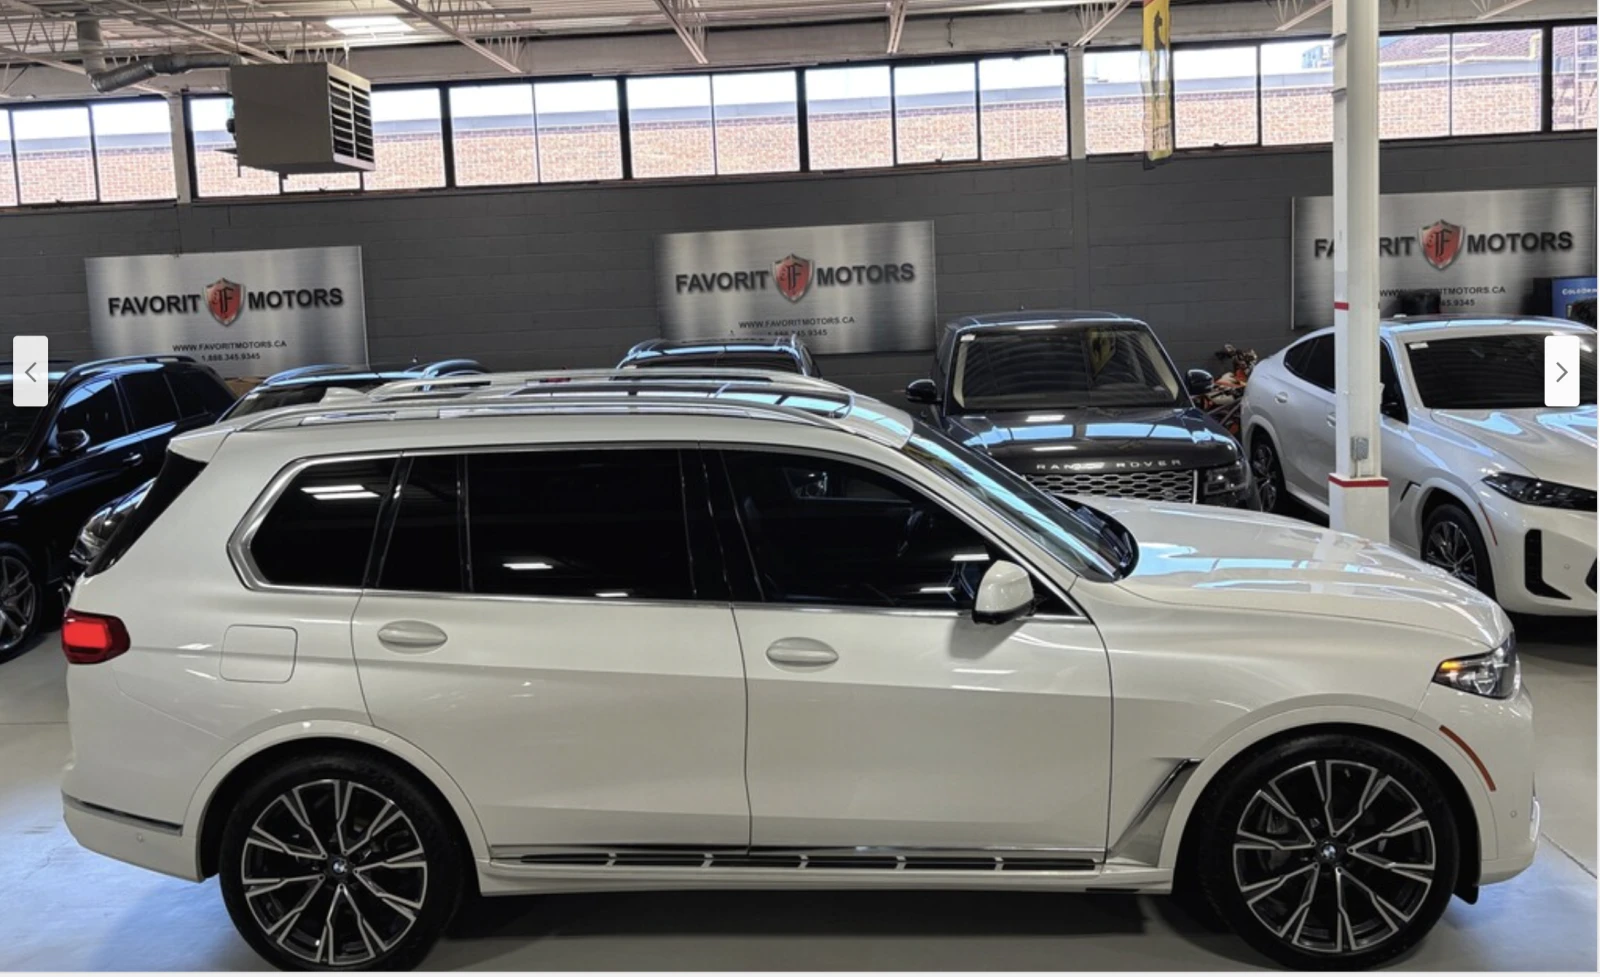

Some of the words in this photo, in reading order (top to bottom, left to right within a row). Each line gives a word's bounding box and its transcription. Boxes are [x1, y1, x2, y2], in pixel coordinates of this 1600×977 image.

[1315, 236, 1415, 258] FRIT
[1467, 231, 1573, 254] MOTORS
[675, 270, 769, 293] FAVORIT
[817, 263, 915, 286] MOTORS
[108, 294, 201, 316] FAVORIT
[249, 287, 344, 310] MOTORS
[738, 316, 855, 329] WWW.FAVORITMOTORS.CA
[172, 340, 287, 352] WWW.FAVORITMOTORS.CA
[1116, 459, 1181, 468] ROVER
